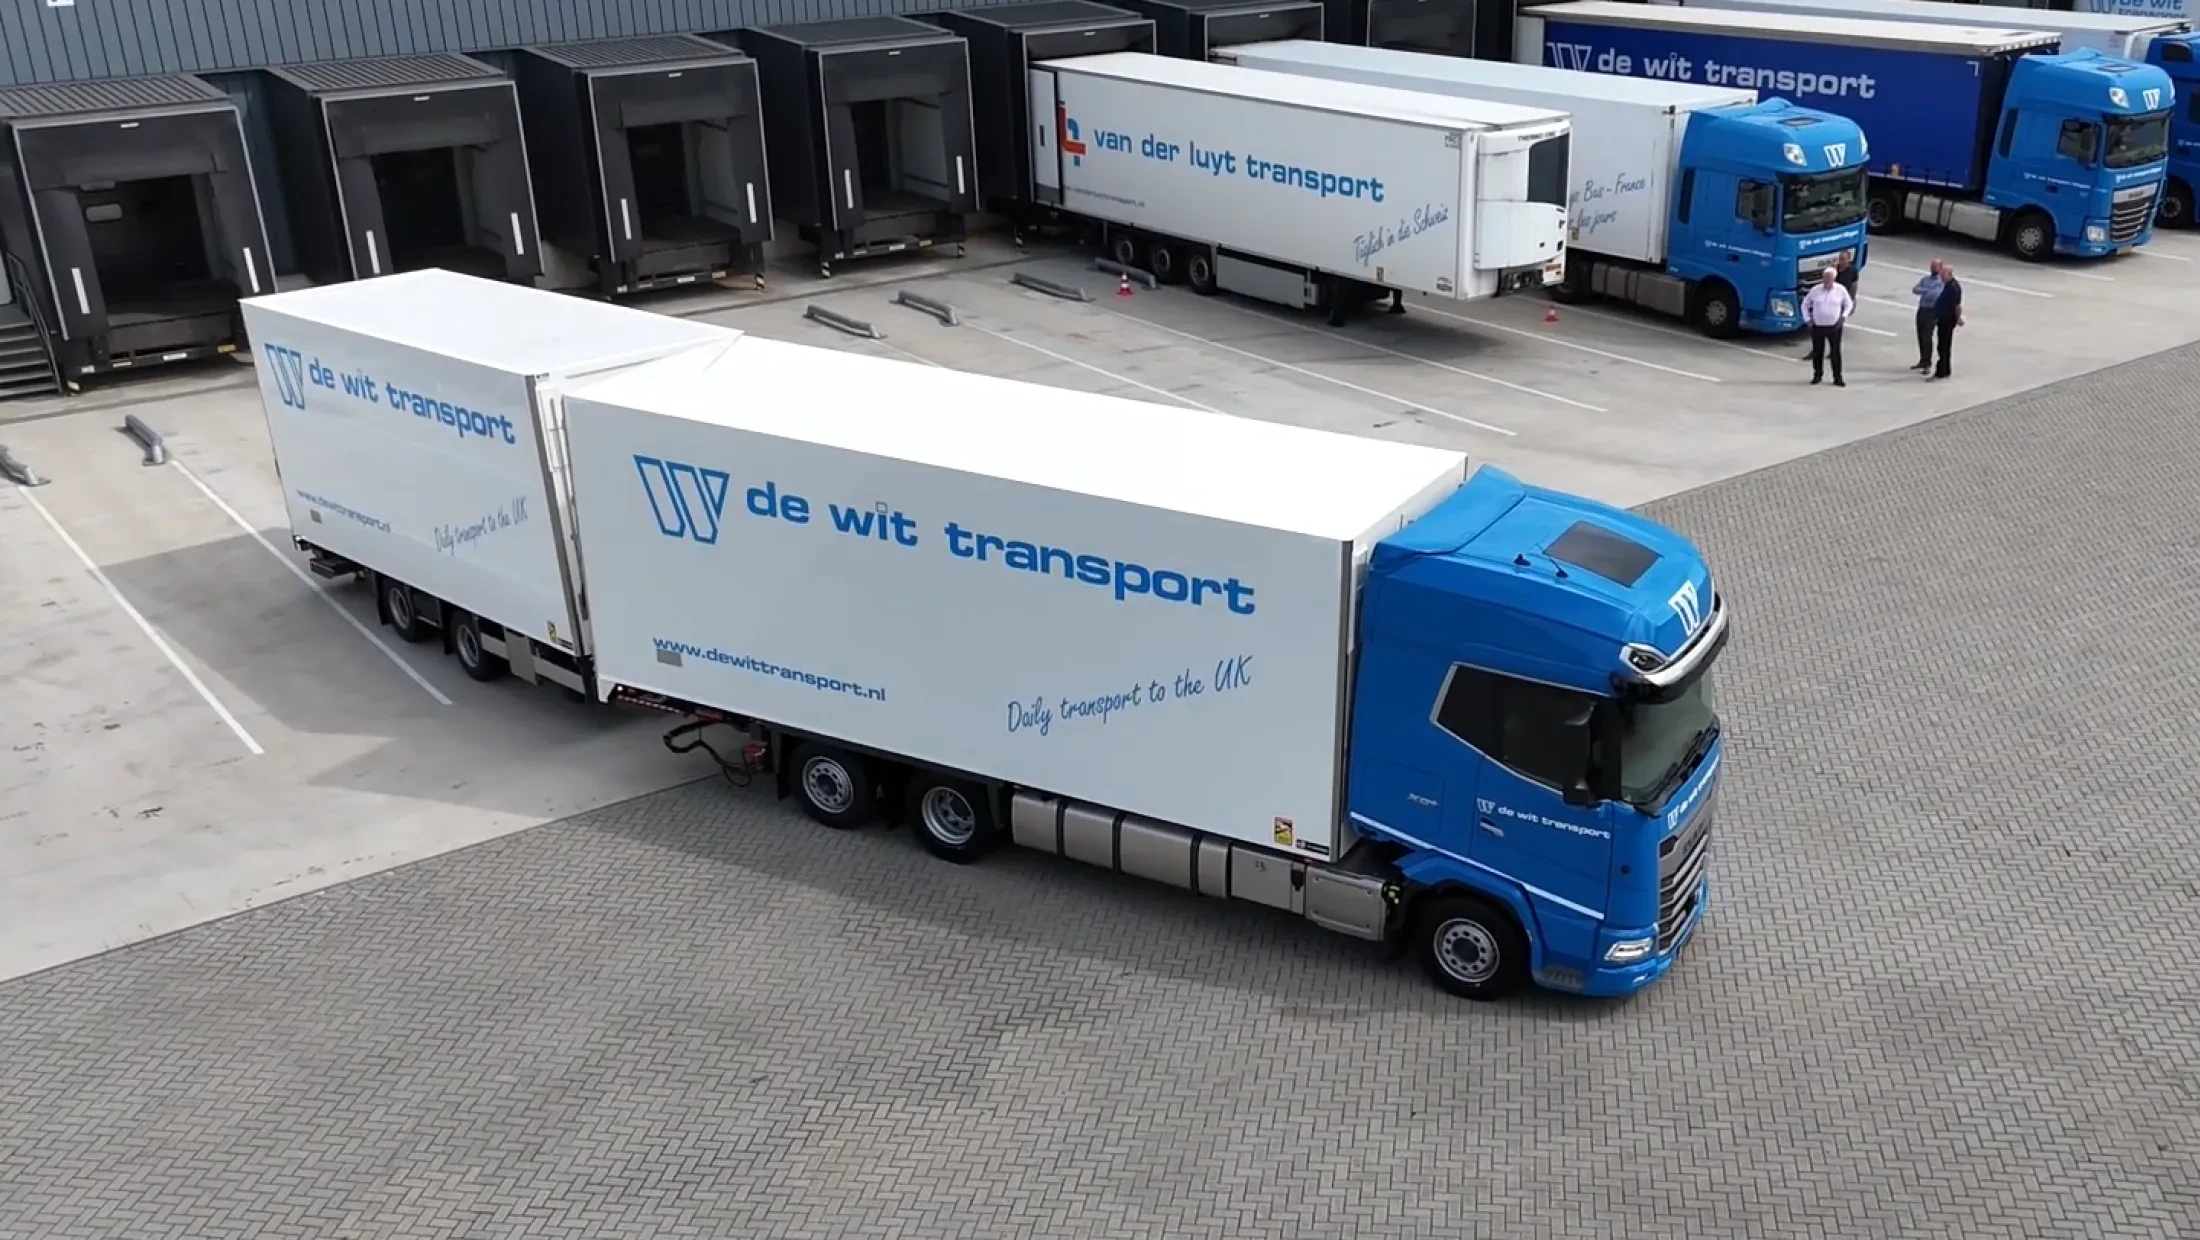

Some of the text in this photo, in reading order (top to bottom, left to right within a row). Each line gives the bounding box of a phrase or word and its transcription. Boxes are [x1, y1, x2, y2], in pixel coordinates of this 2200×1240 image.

[1598, 48, 1632, 74] de
[1644, 51, 1692, 81] wit
[1704, 59, 1876, 99] transport
[1093, 128, 1385, 203] van der luyt transport
[309, 356, 335, 389] de
[341, 368, 379, 403] wit
[385, 381, 516, 444] transport
[746, 480, 811, 525] de
[828, 501, 918, 547] wit
[944, 521, 1256, 616] transport
[652, 636, 887, 702] www.dewittransport.nl
[1007, 654, 1253, 736] Daily transport to the UK
[1497, 806, 1515, 817] de
[1517, 811, 1539, 823] wit
[1541, 816, 1611, 840] transport
